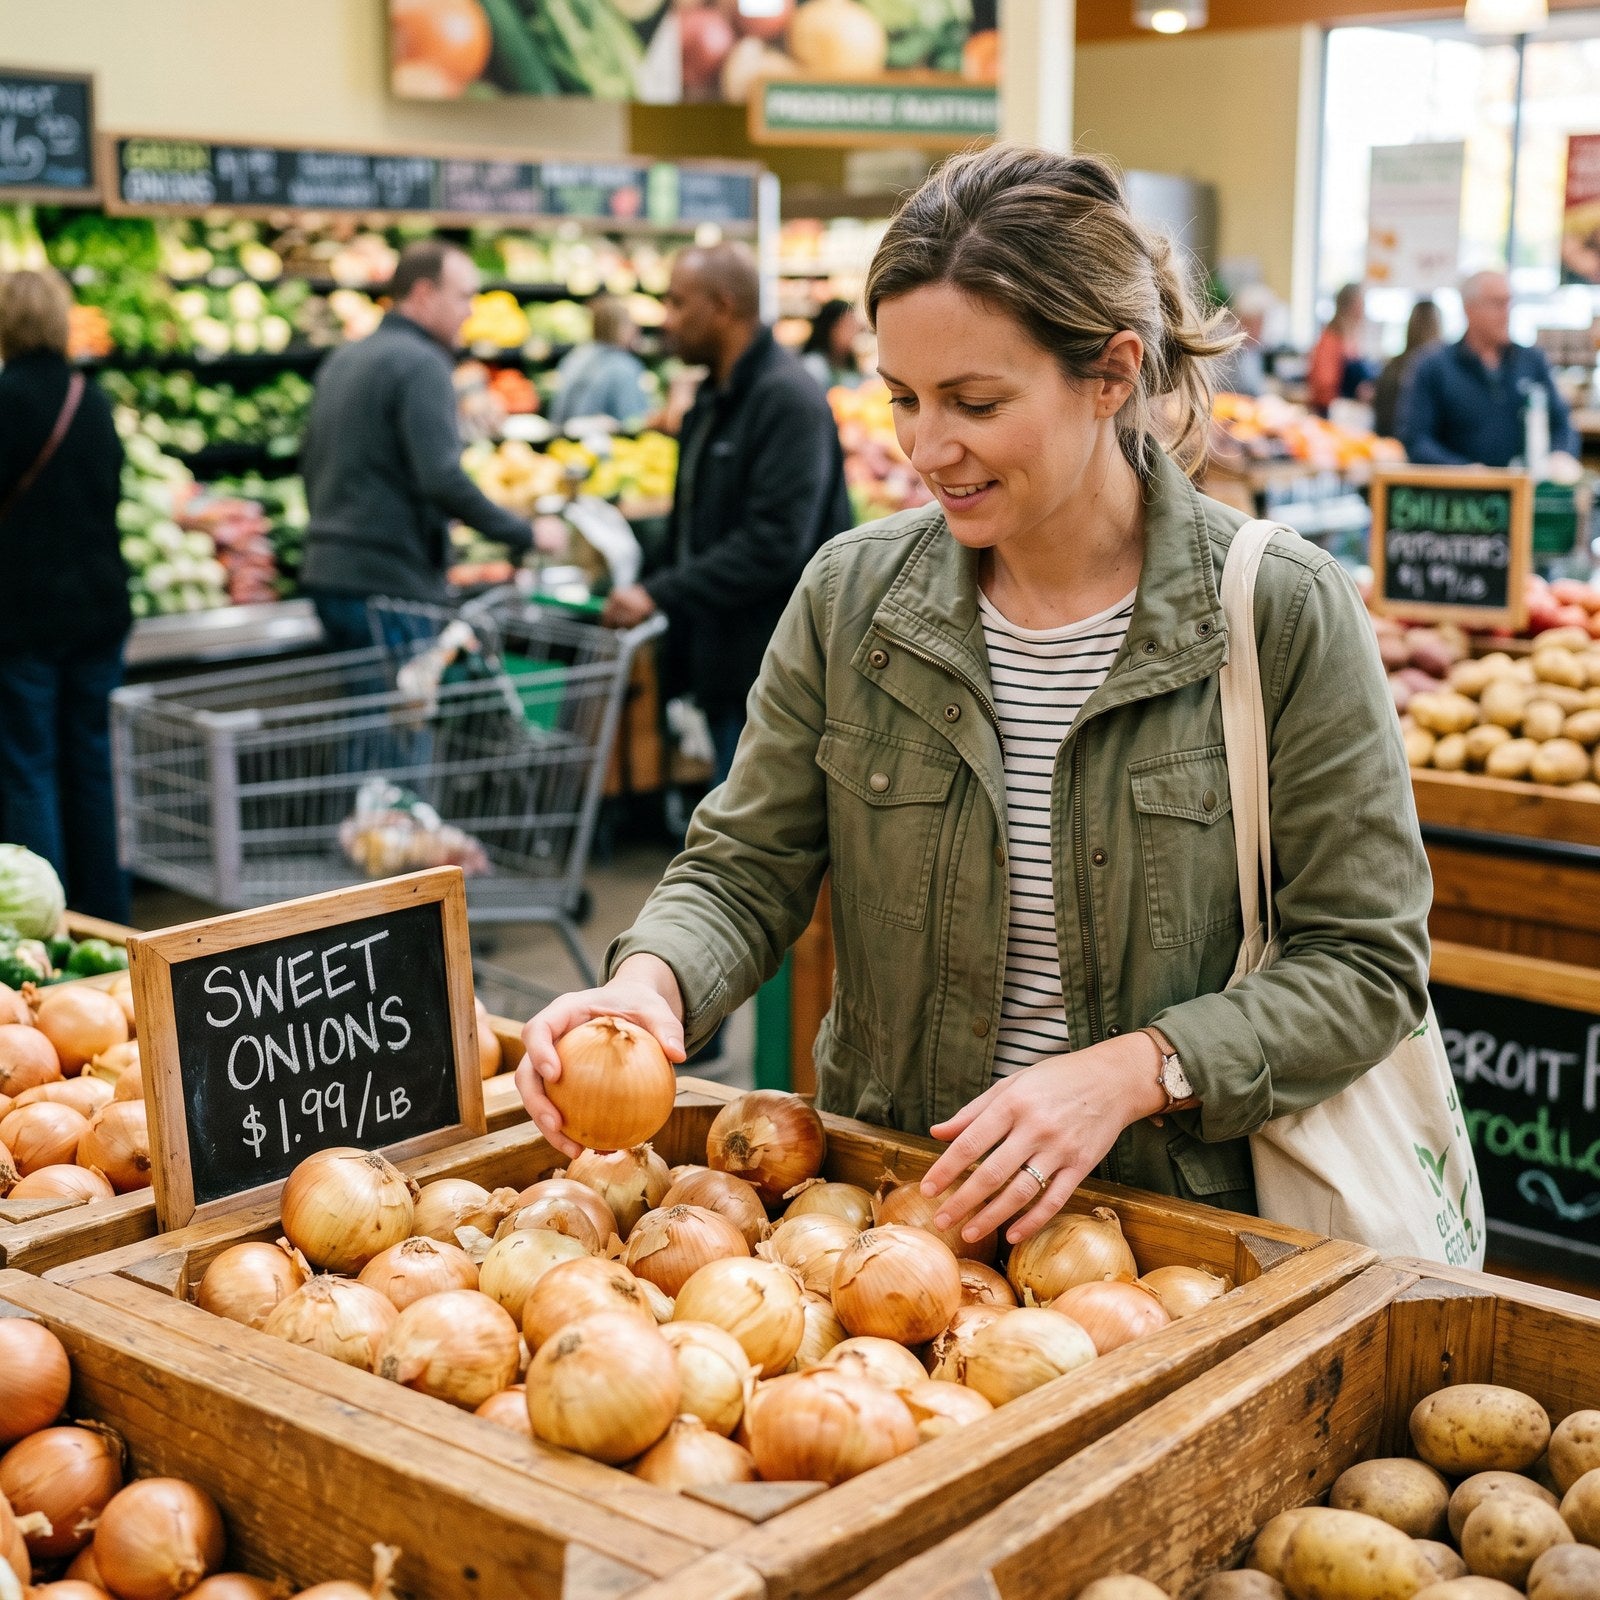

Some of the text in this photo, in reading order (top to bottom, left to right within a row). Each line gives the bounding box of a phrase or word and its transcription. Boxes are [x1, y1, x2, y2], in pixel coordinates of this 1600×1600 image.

[203, 930, 389, 1028] SWEET
[227, 995, 412, 1091] ONIONS
[242, 1070, 412, 1158] $1.99/LB
